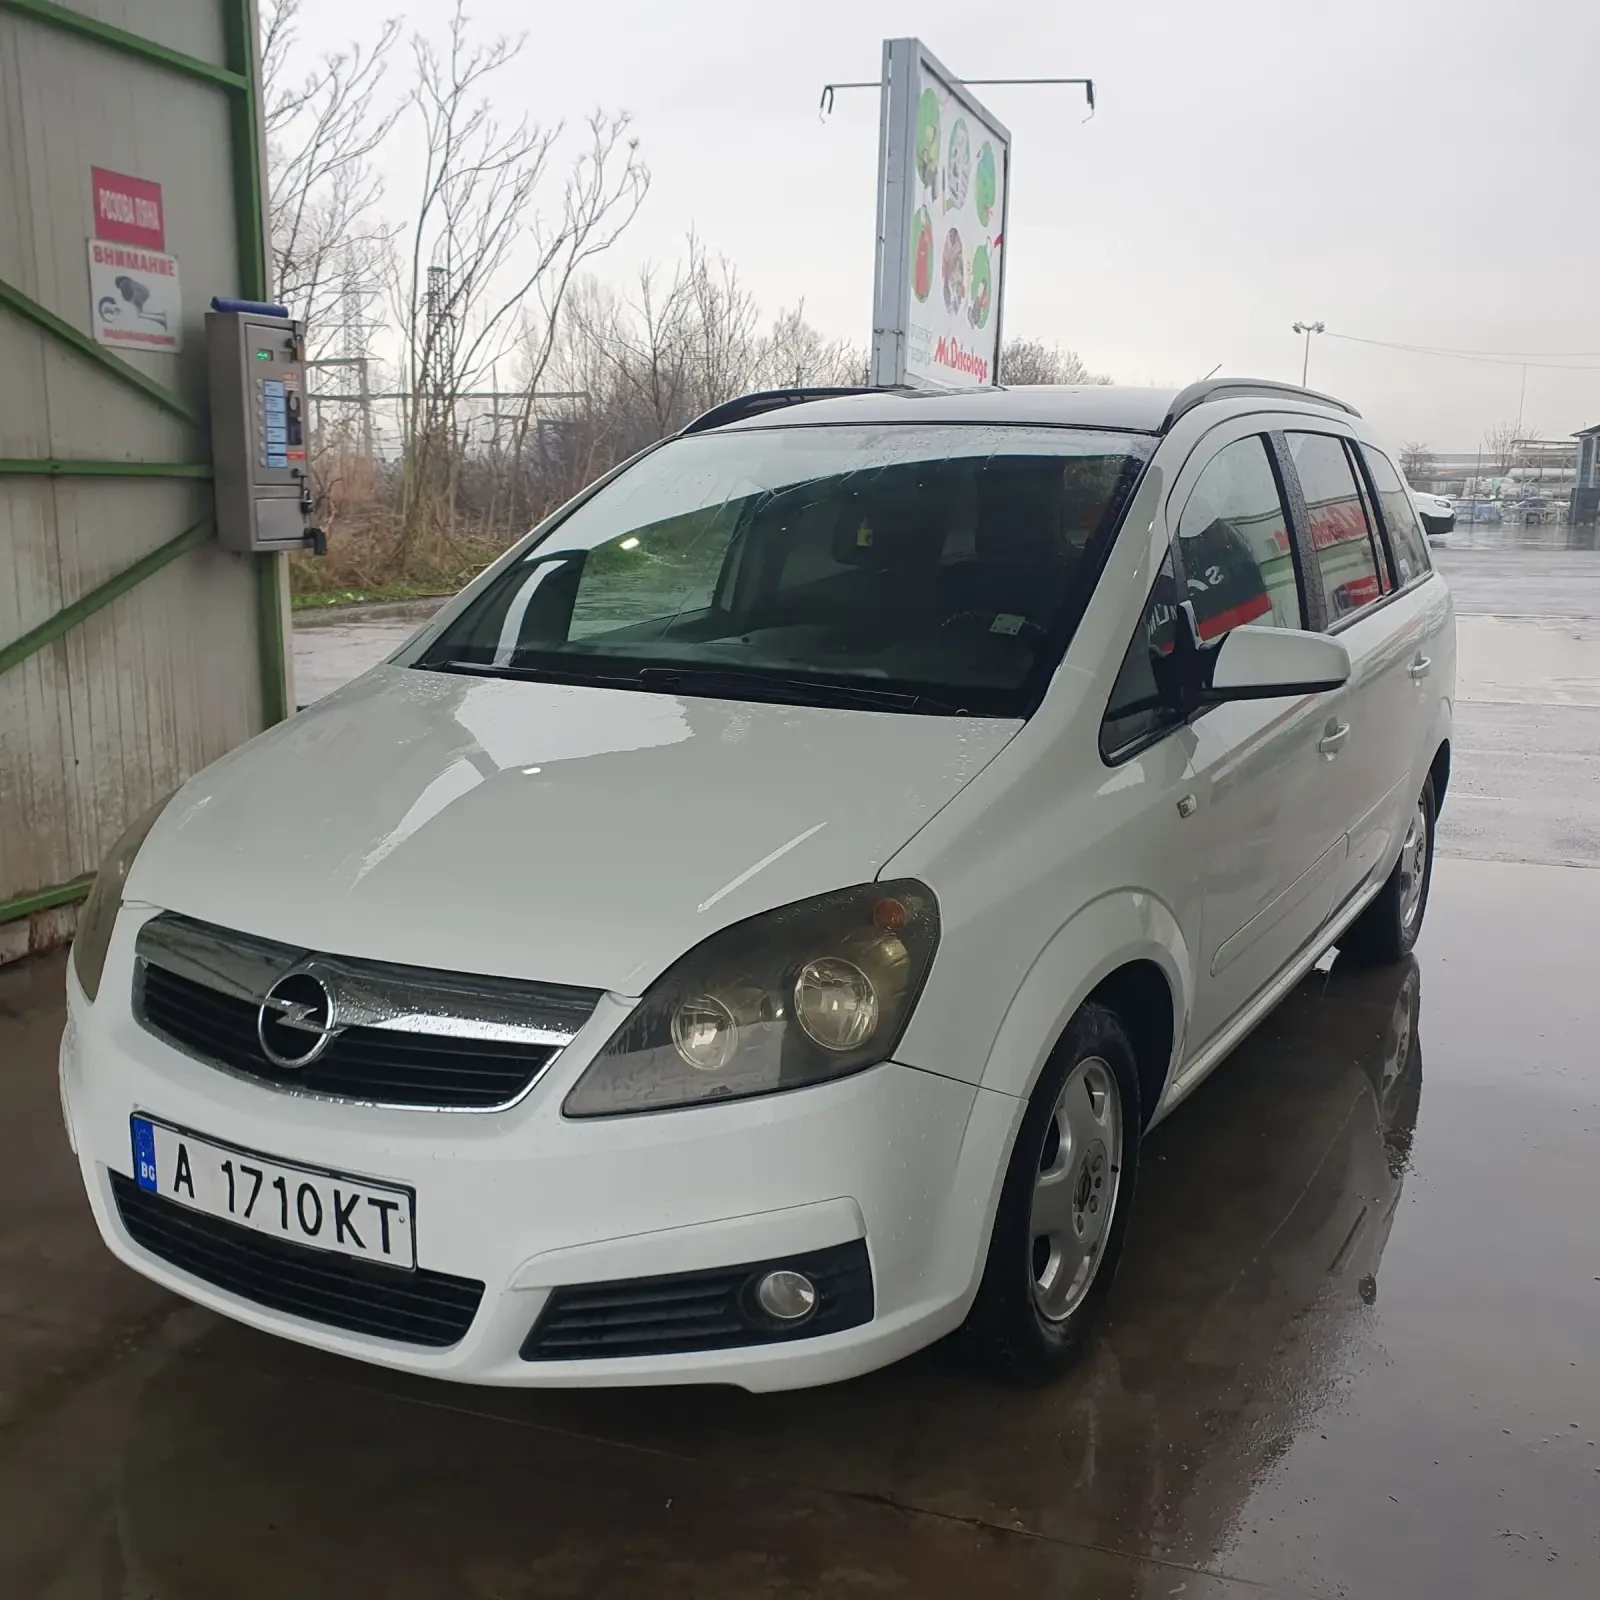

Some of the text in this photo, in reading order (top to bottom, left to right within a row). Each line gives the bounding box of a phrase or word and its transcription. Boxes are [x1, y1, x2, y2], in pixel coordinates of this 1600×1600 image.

[93, 245, 175, 276] ВНИМАНИЕ
[141, 1161, 156, 1181] BG
[173, 1143, 195, 1199] A
